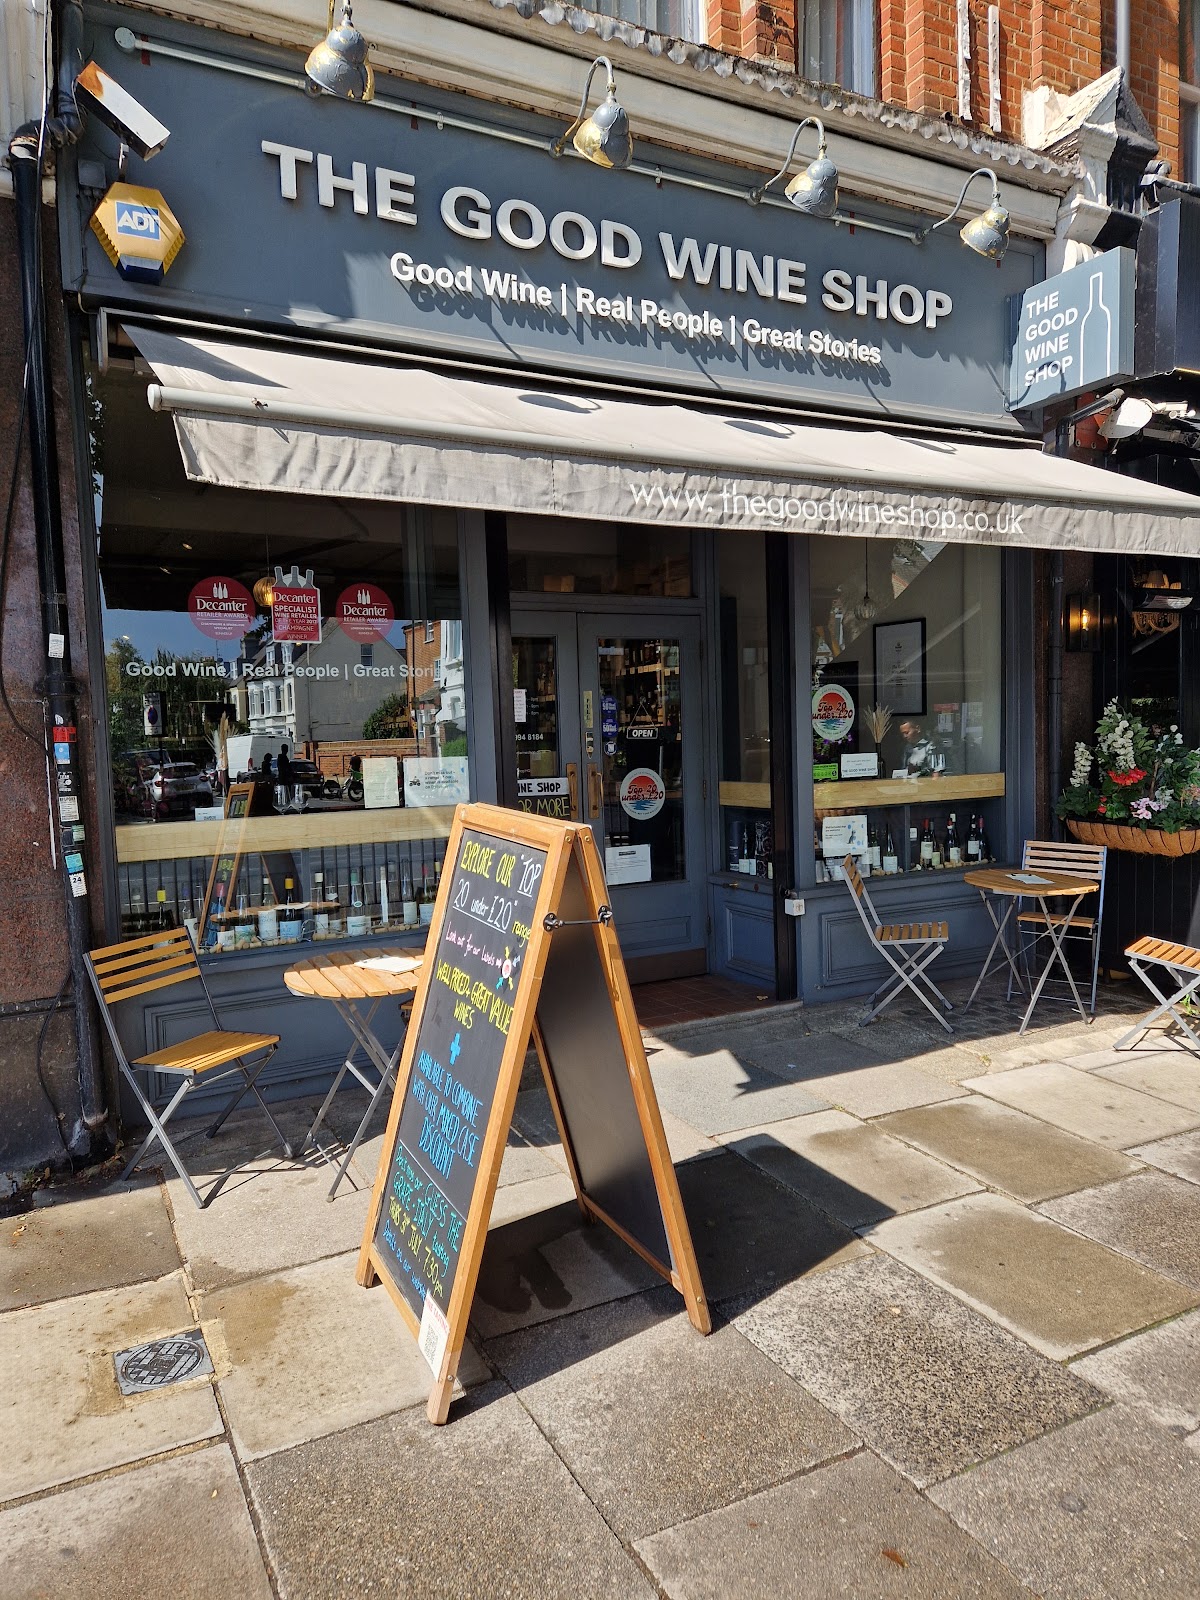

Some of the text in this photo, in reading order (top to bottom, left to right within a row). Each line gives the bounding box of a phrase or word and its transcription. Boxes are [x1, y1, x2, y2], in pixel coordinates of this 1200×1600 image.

[118, 210, 160, 233] ADT
[261, 140, 954, 329] THE GOOD WINE SHOP
[390, 252, 472, 292] Good
[481, 268, 552, 306] Wine
[576, 287, 633, 322] Real
[641, 300, 723, 340] People
[743, 318, 804, 352] Great
[809, 330, 881, 364] Stories
[1026, 291, 1059, 319] THE
[1025, 307, 1078, 341] GOOD
[1024, 333, 1070, 364] WINE
[1024, 355, 1073, 387] SHOP
[196, 599, 248, 612] Decanter
[274, 592, 316, 603] Decanter
[274, 605, 317, 613] SPECIALIST
[343, 604, 388, 616] Decanter
[278, 624, 314, 632] CHAMPAGNE
[125, 661, 177, 677] Good
[182, 662, 227, 677] Wine
[242, 663, 279, 677] Real
[285, 663, 340, 680] People
[353, 663, 395, 678] Great
[399, 664, 438, 678] Stori
[631, 729, 653, 738] OPEN
[518, 782, 561, 793] INE SHOP
[537, 796, 570, 817] MORE
[460, 840, 496, 879] EXPLORE
[496, 853, 516, 888] OUR
[454, 878, 470, 908] 20
[470, 896, 489, 916] under
[511, 921, 531, 948] range
[453, 998, 475, 1030] WINES
[470, 981, 492, 1014] GREAT
[488, 993, 514, 1036] VALUE
[417, 1049, 483, 1128] AVAILABLE TO COMBINE
[412, 1074, 480, 1168] WITH OUR MIXED CASE
[418, 1116, 456, 1180] DISCOUNT
[413, 1198, 435, 1240] ITALY
[424, 1182, 448, 1228] GUESS
[446, 1211, 462, 1253] THE
